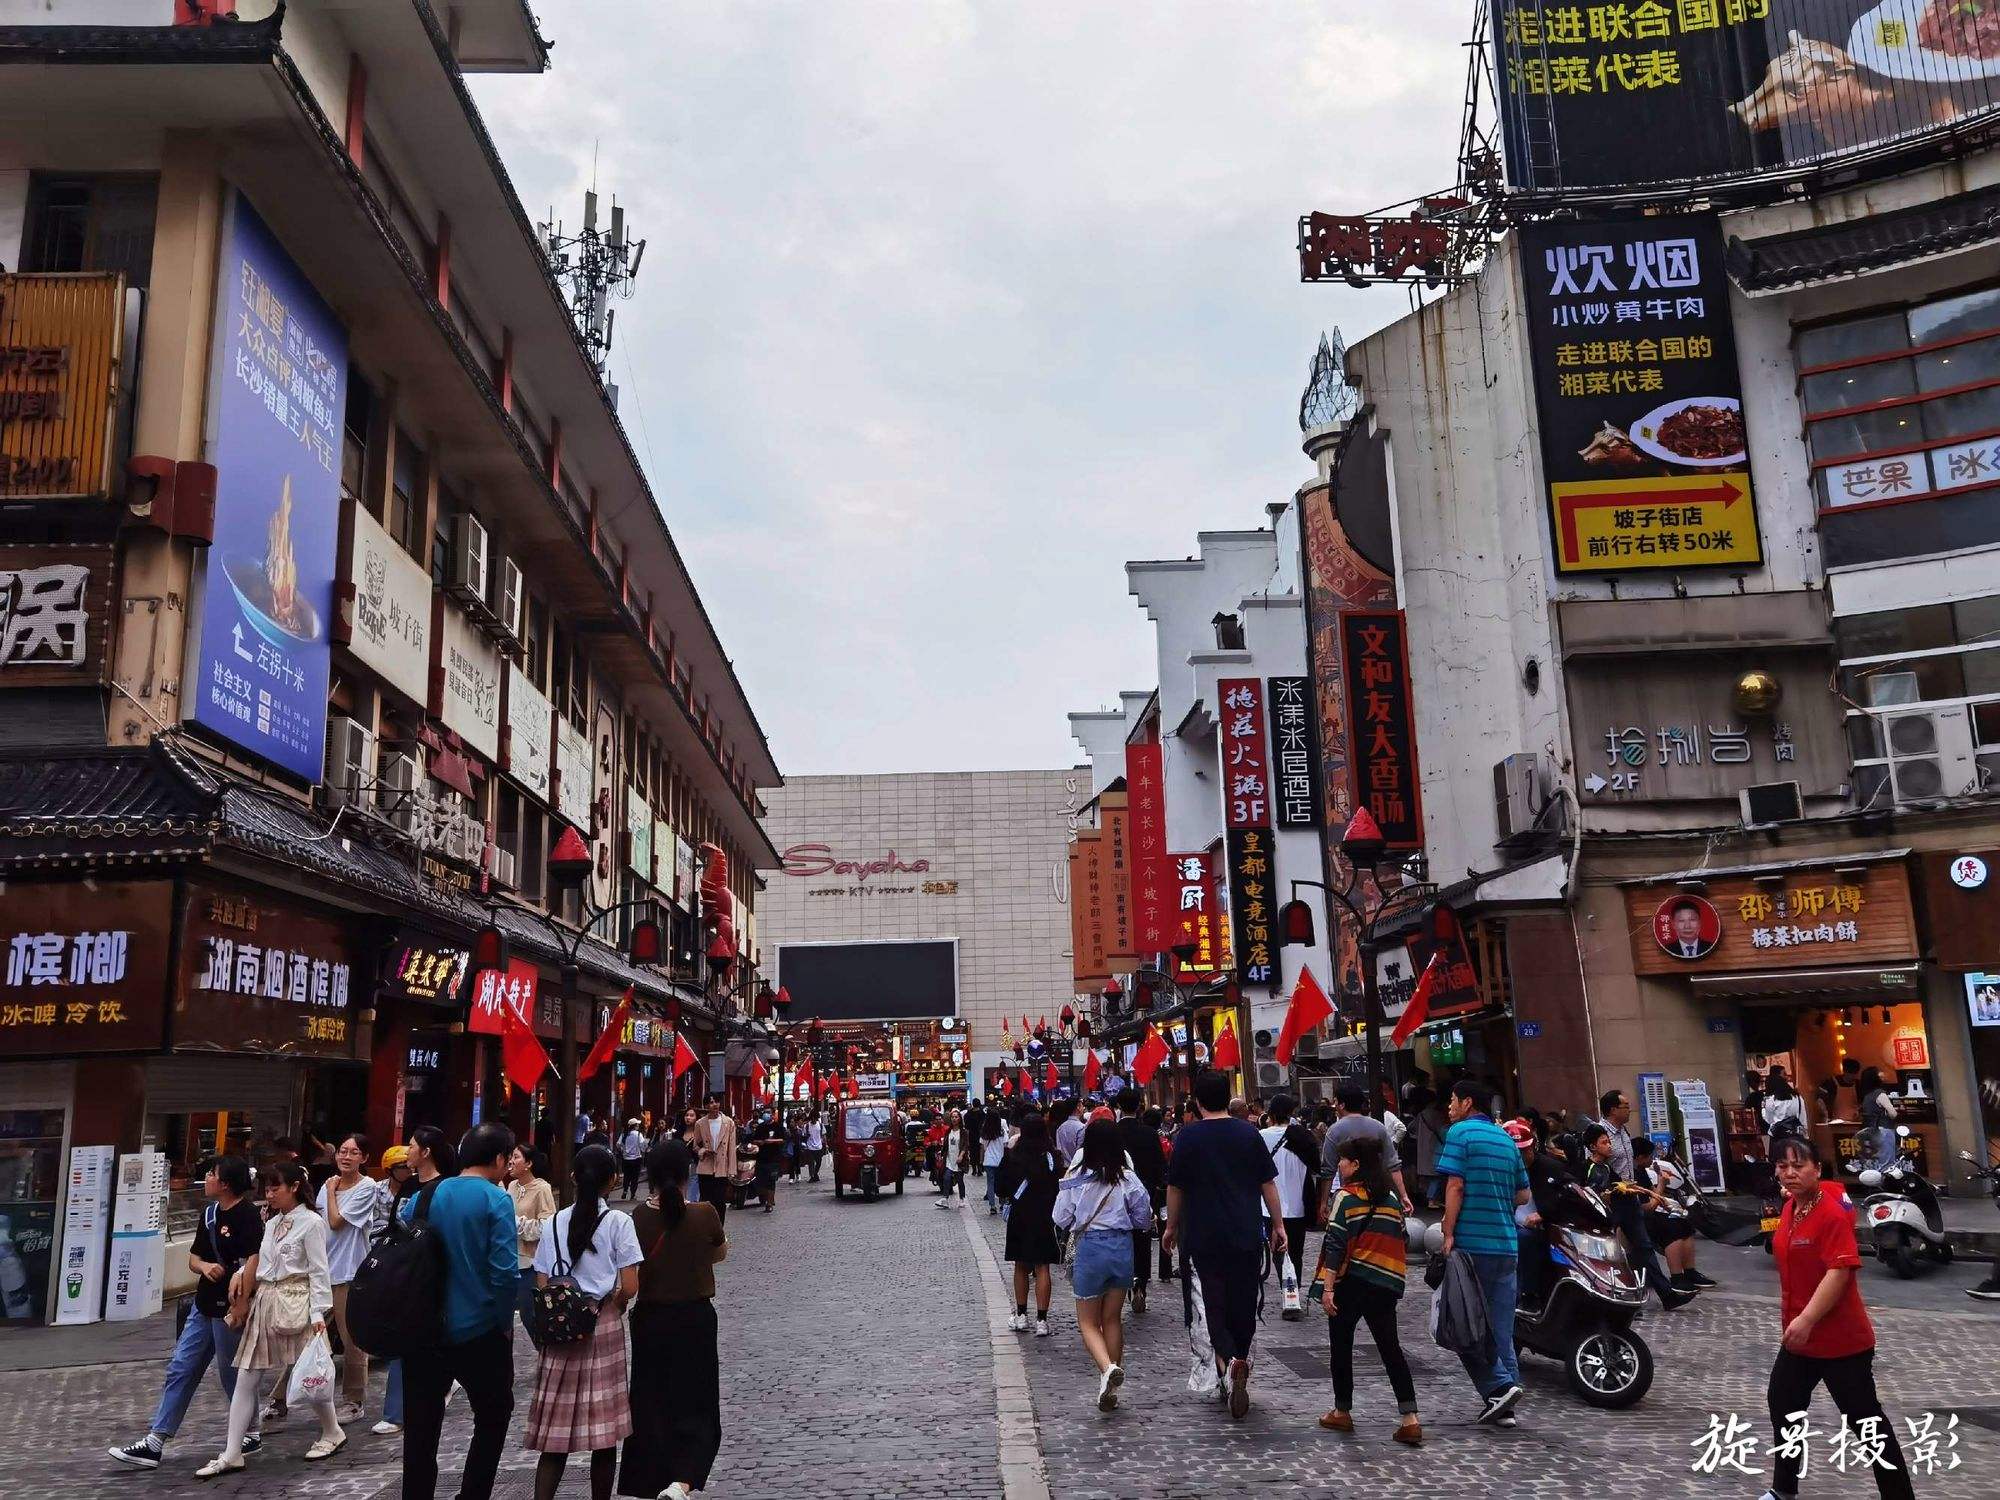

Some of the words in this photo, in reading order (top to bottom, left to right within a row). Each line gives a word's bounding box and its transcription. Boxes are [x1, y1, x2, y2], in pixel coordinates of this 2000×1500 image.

[1510, 49, 1682, 95] 湘菜代表
[1546, 238, 1700, 295] 炊烟
[1553, 297, 1705, 327] 小炒黄牛肉
[1556, 335, 1712, 367] 走进联合国的
[1559, 368, 1664, 396] 湘菜代表
[236, 346, 333, 473] 长沙销量王人气王
[1842, 461, 1912, 497] 芒果
[1948, 443, 2000, 480] 冰
[1613, 507, 1703, 529] 坡子街店
[1588, 531, 1734, 557] 前行右转50米
[389, 598, 423, 652] 坡子街
[213, 660, 252, 701] 社会主义
[257, 642, 305, 692] 左拐十米
[211, 686, 251, 723] 核心价值观
[1358, 624, 1404, 824] 文和友大香肠
[1774, 723, 1795, 762] 烤肉
[1611, 773, 1639, 791] 2F
[1233, 800, 1264, 822] 3F
[1138, 755, 1160, 942] 千年老长沙一个坡子街
[1177, 857, 1206, 911] 潘厨
[1198, 914, 1211, 960] 经典湘菜
[6, 931, 127, 986] 槟榔
[208, 936, 349, 1007] 湖南烟酒槟榔
[1247, 966, 1271, 981] 4F
[1, 1002, 122, 1026] 冰啤冷饮
